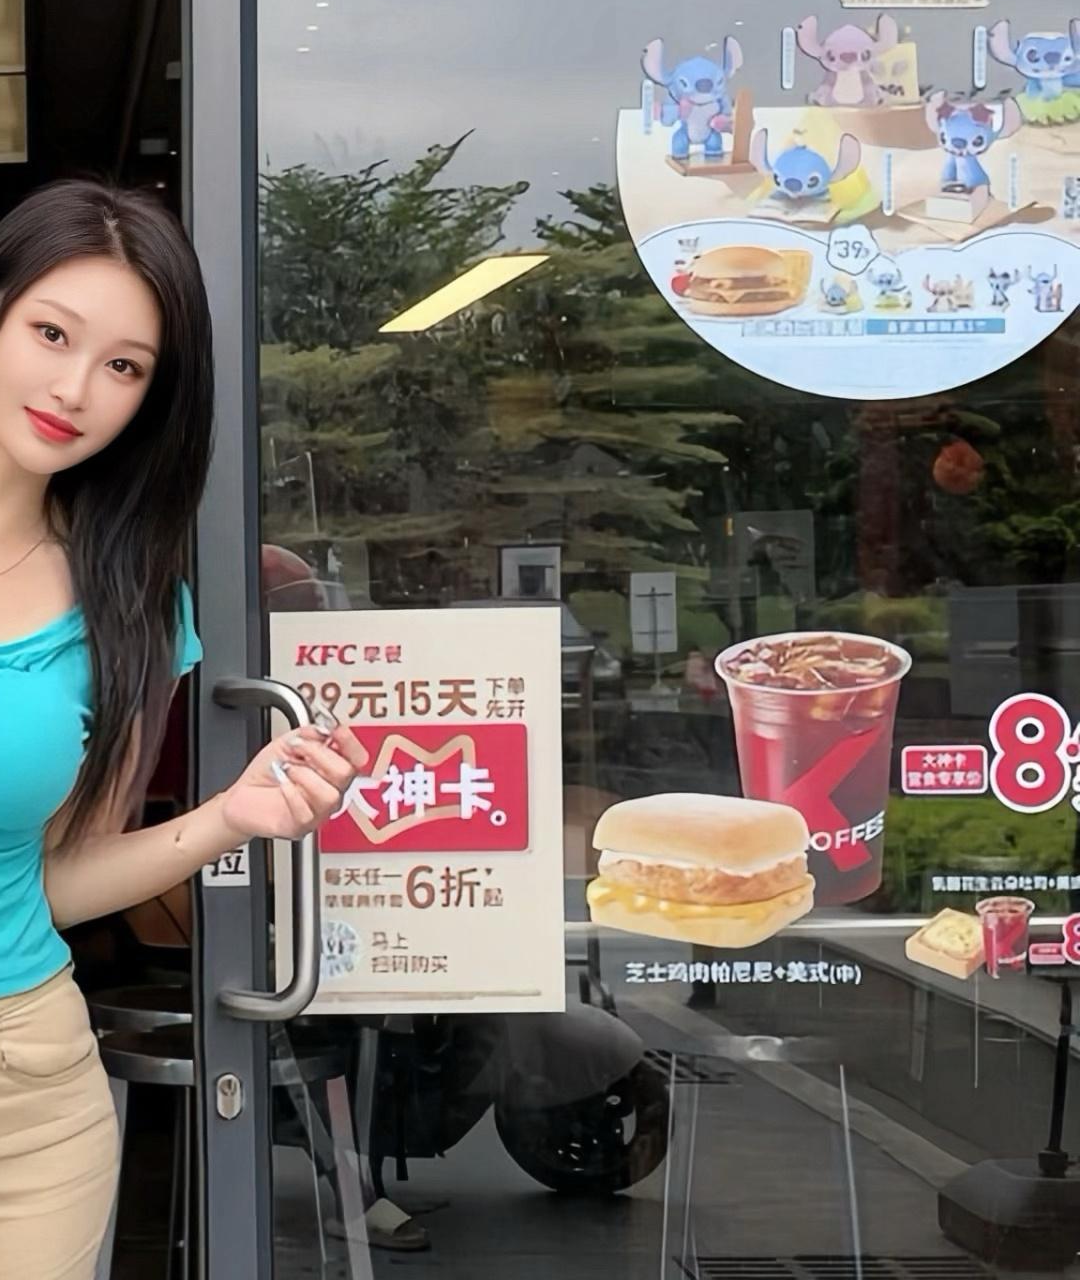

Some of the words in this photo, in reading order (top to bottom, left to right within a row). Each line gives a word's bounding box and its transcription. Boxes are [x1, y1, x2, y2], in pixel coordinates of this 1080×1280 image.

[296, 645, 357, 666] KFC
[363, 645, 402, 663] 早餐
[372, 932, 408, 950] 马上
[372, 955, 448, 973] 扫码购买
